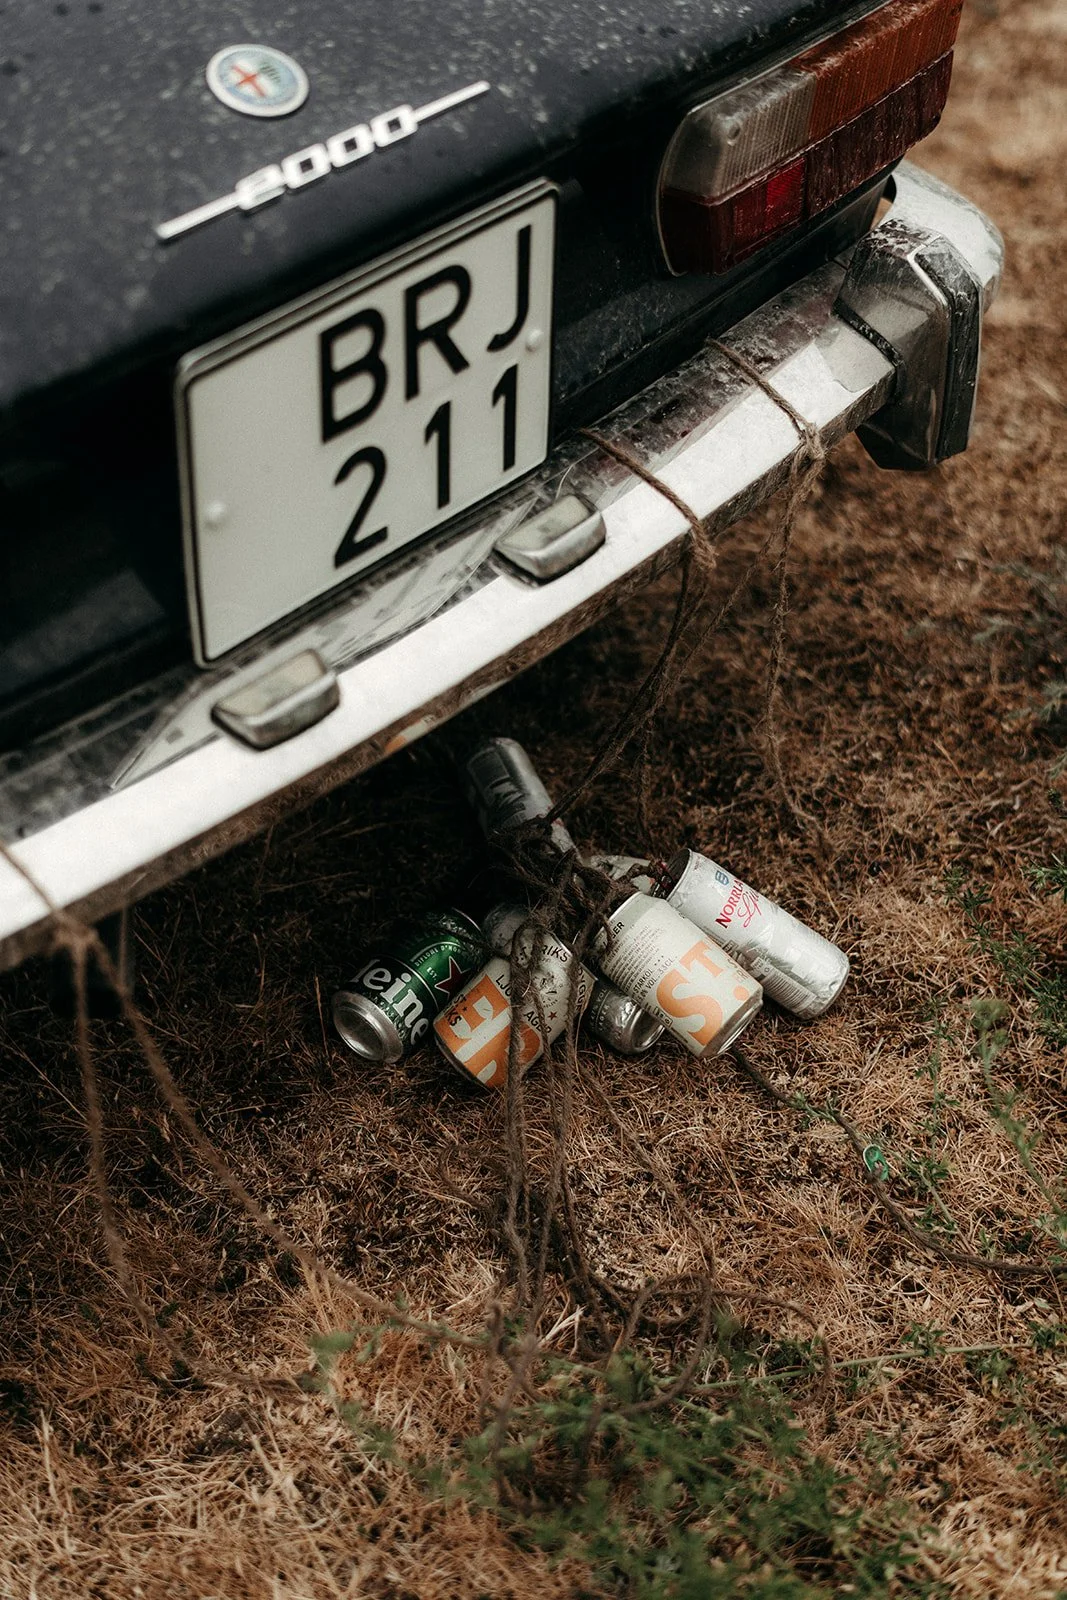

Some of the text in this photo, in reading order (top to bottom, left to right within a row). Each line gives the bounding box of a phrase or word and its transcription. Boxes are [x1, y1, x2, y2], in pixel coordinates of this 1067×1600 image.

[235, 103, 418, 211] 2000
[318, 224, 532, 445] BRJ
[333, 363, 519, 570] 211
